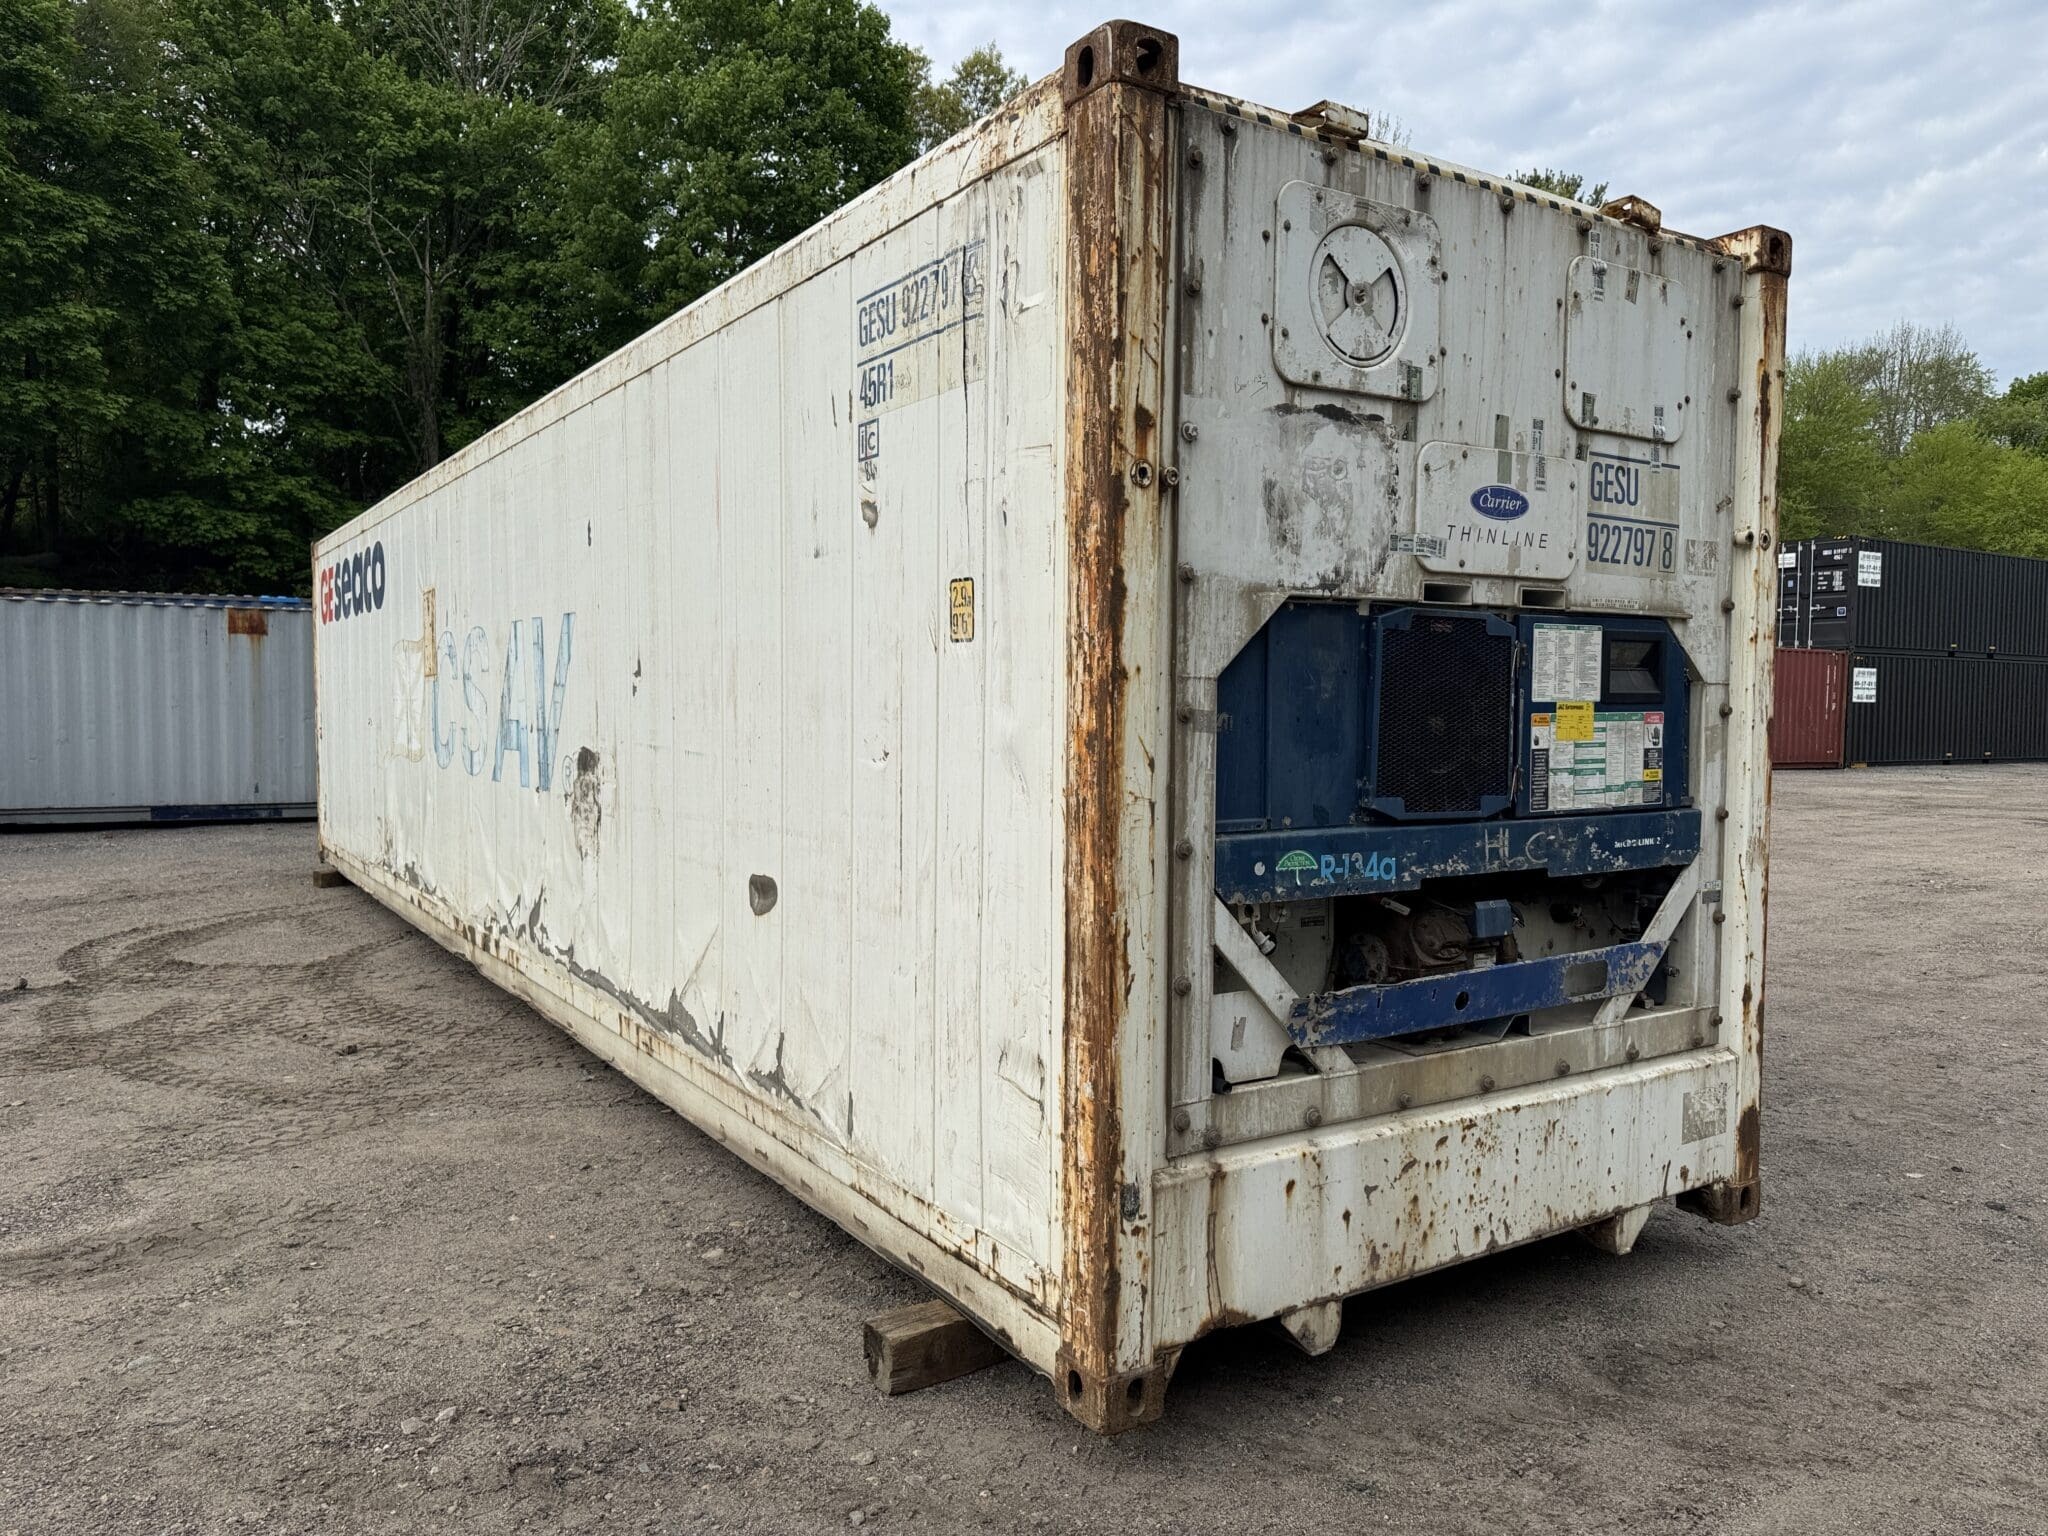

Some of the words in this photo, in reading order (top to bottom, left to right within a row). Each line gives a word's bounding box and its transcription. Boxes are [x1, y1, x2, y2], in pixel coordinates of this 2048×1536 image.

[859, 292, 896, 347] GESU
[902, 257, 959, 328] 922797
[859, 358, 894, 409] 45R1
[1480, 487, 1522, 511] Carrier
[1591, 461, 1639, 506] GESU
[1447, 524, 1549, 549] THINLINE
[1587, 522, 1656, 567] 922797
[1662, 531, 1673, 569] 8
[431, 611, 576, 792] CSAV
[1320, 852, 1397, 884] R-134a
